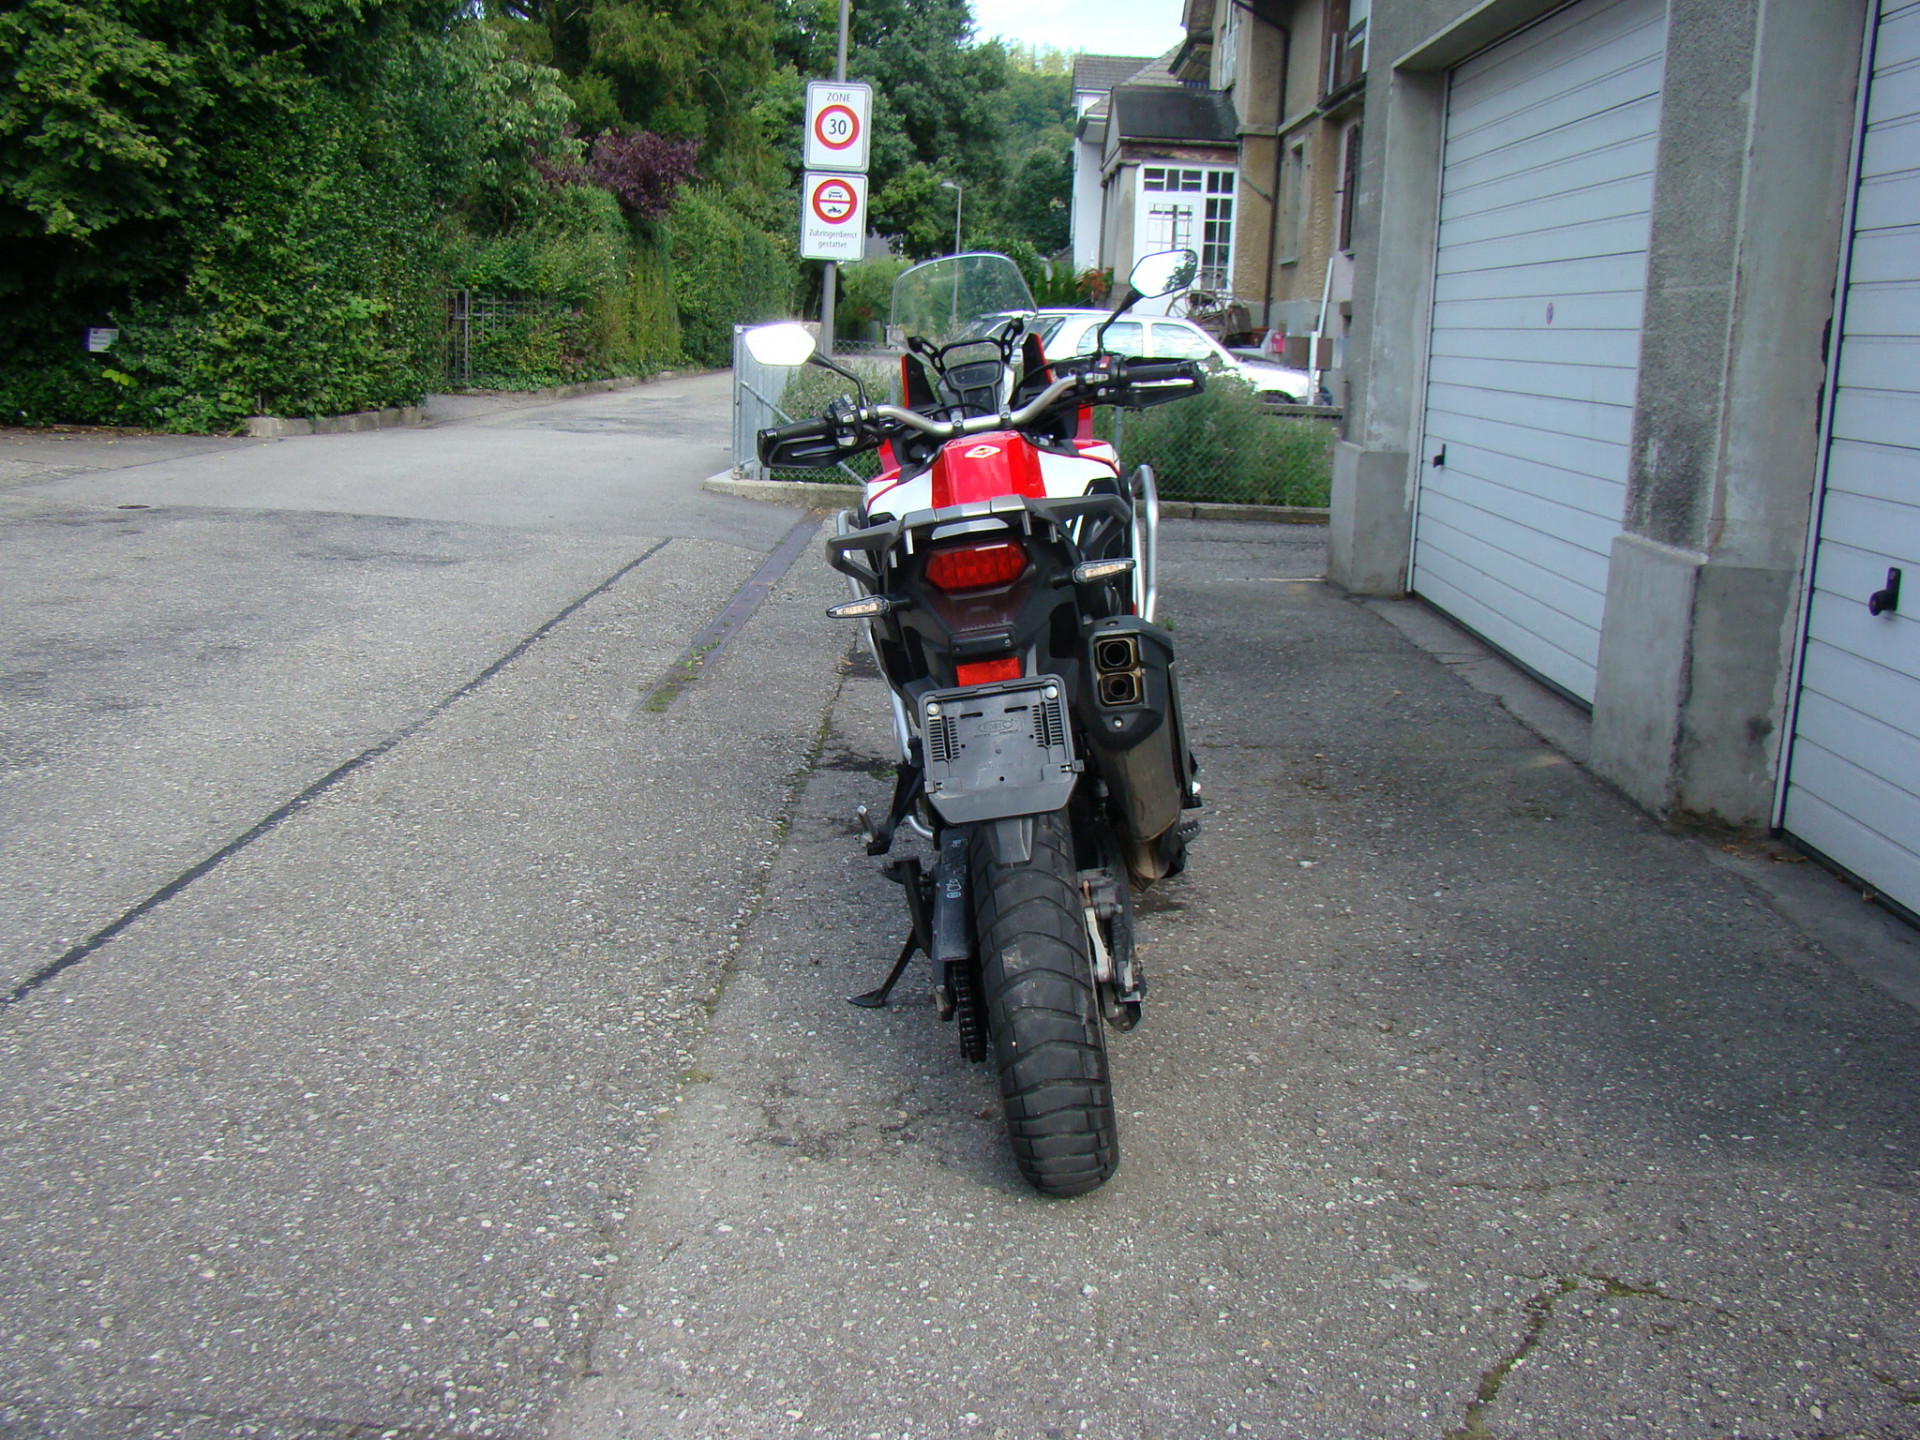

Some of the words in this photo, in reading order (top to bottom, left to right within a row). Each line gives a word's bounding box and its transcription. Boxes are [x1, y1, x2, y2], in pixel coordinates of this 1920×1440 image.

[826, 92, 851, 103] ZONE
[828, 119, 847, 135] 30
[809, 229, 857, 240] Zubringerdienst
[818, 241, 847, 249] gestattet
